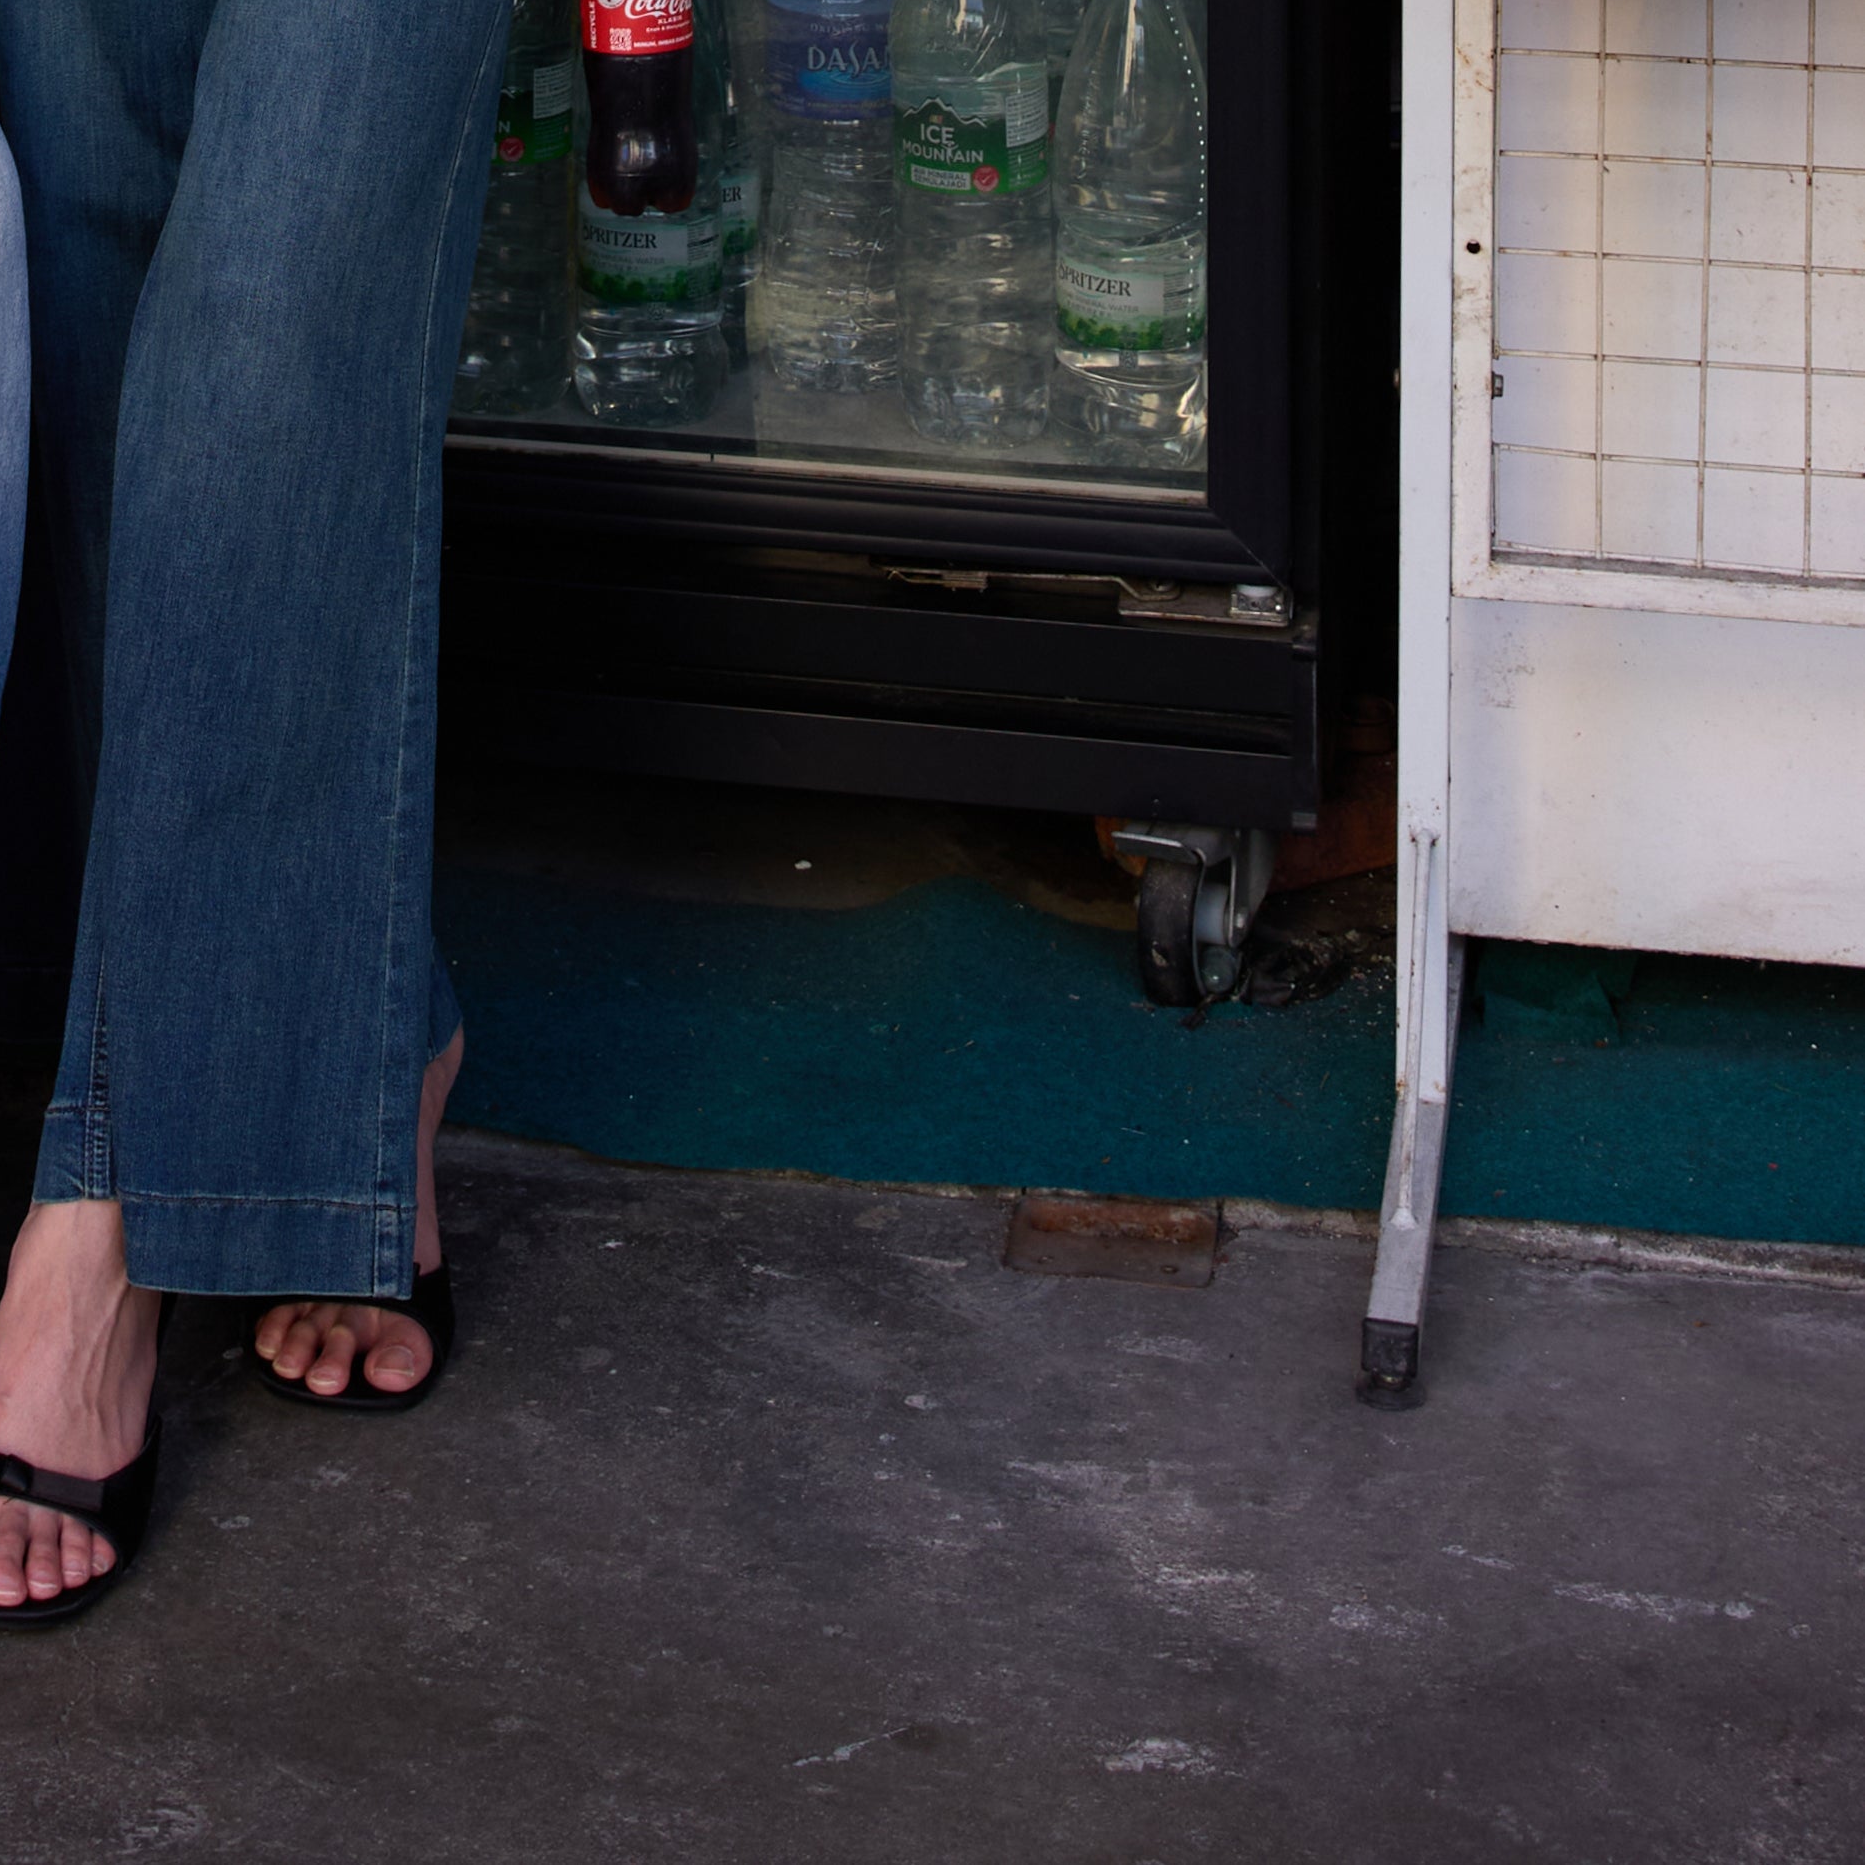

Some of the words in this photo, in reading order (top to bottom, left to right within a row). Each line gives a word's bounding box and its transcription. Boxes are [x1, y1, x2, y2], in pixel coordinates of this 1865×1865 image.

[588, 1, 597, 49] RECYCLE
[807, 39, 887, 79] DASA
[920, 123, 955, 145] ICE
[902, 137, 984, 165] MOUNTAIN
[912, 167, 926, 176] AIR
[926, 168, 966, 181] MINERAL
[913, 173, 966, 189] SEMULAJADI
[1057, 261, 1132, 297] SPRITZER
